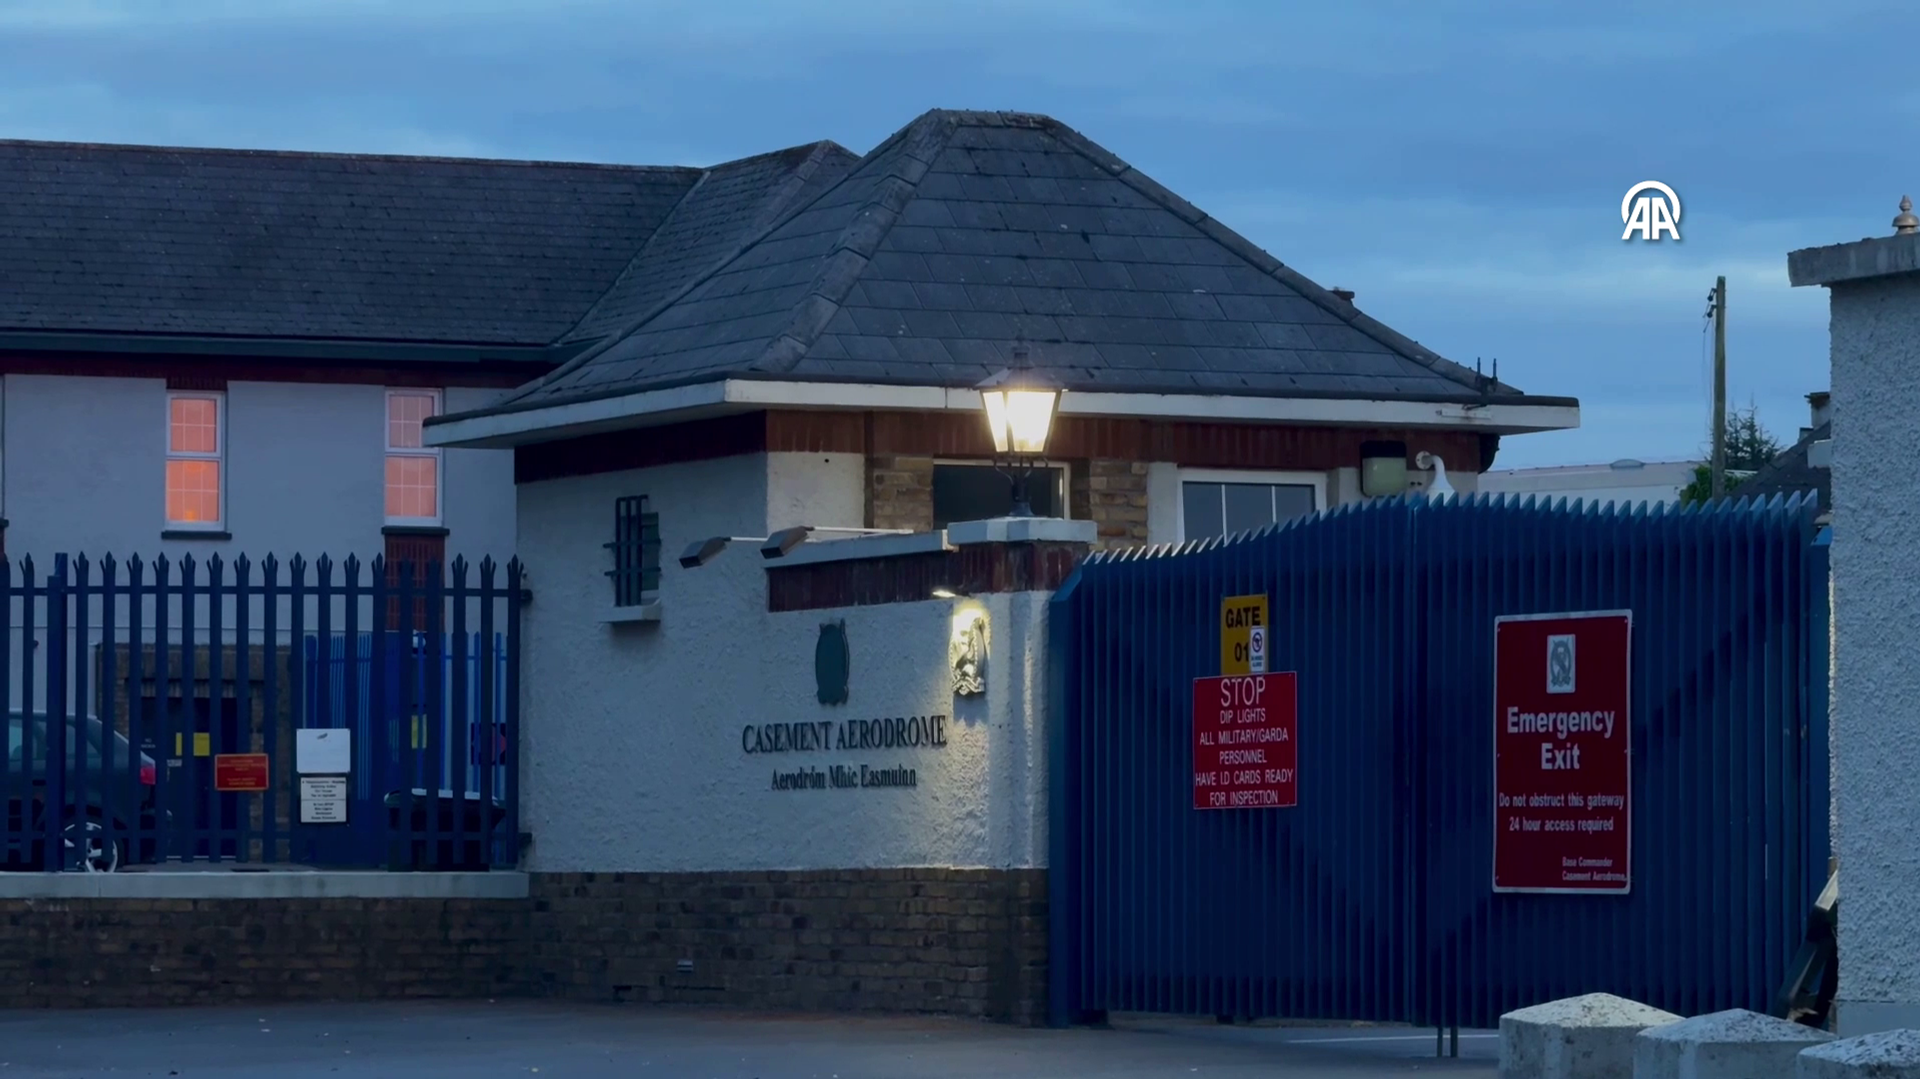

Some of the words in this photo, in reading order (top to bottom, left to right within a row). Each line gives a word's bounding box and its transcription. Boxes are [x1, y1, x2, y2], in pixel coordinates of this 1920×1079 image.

[1225, 606, 1261, 628] GATE
[1234, 642, 1249, 662] 01
[1220, 676, 1266, 707] STOP
[1220, 709, 1233, 724] DIP
[1237, 708, 1266, 723] LIGHTS
[1507, 706, 1615, 739] Emergency
[742, 720, 833, 754] CASEMENT
[836, 715, 948, 750] AERODROME
[1200, 732, 1214, 745] ALL
[1218, 727, 1288, 744] MILITARY/GARDA
[1220, 749, 1267, 765] PERSONNEL
[1541, 742, 1580, 770] Exit
[829, 764, 858, 788] Mhic
[860, 763, 917, 788] Easmuinn
[1195, 771, 1216, 786] HAVE
[1234, 770, 1261, 785] CARDS
[1265, 769, 1293, 783] READY
[1210, 792, 1226, 806] FOR
[1230, 790, 1278, 805] INSPECTION
[1499, 792, 1510, 807] Do
[1512, 794, 1526, 807] not
[1529, 792, 1565, 807] obstruct
[1568, 792, 1584, 807] this
[1587, 793, 1624, 811] gateway
[1509, 816, 1520, 831] 24
[1522, 816, 1541, 831] hour
[1544, 819, 1575, 831] access
[1578, 816, 1614, 834] required
[1562, 856, 1577, 867] Base
[1578, 856, 1613, 867] Commander
[1562, 870, 1591, 881] Casement
